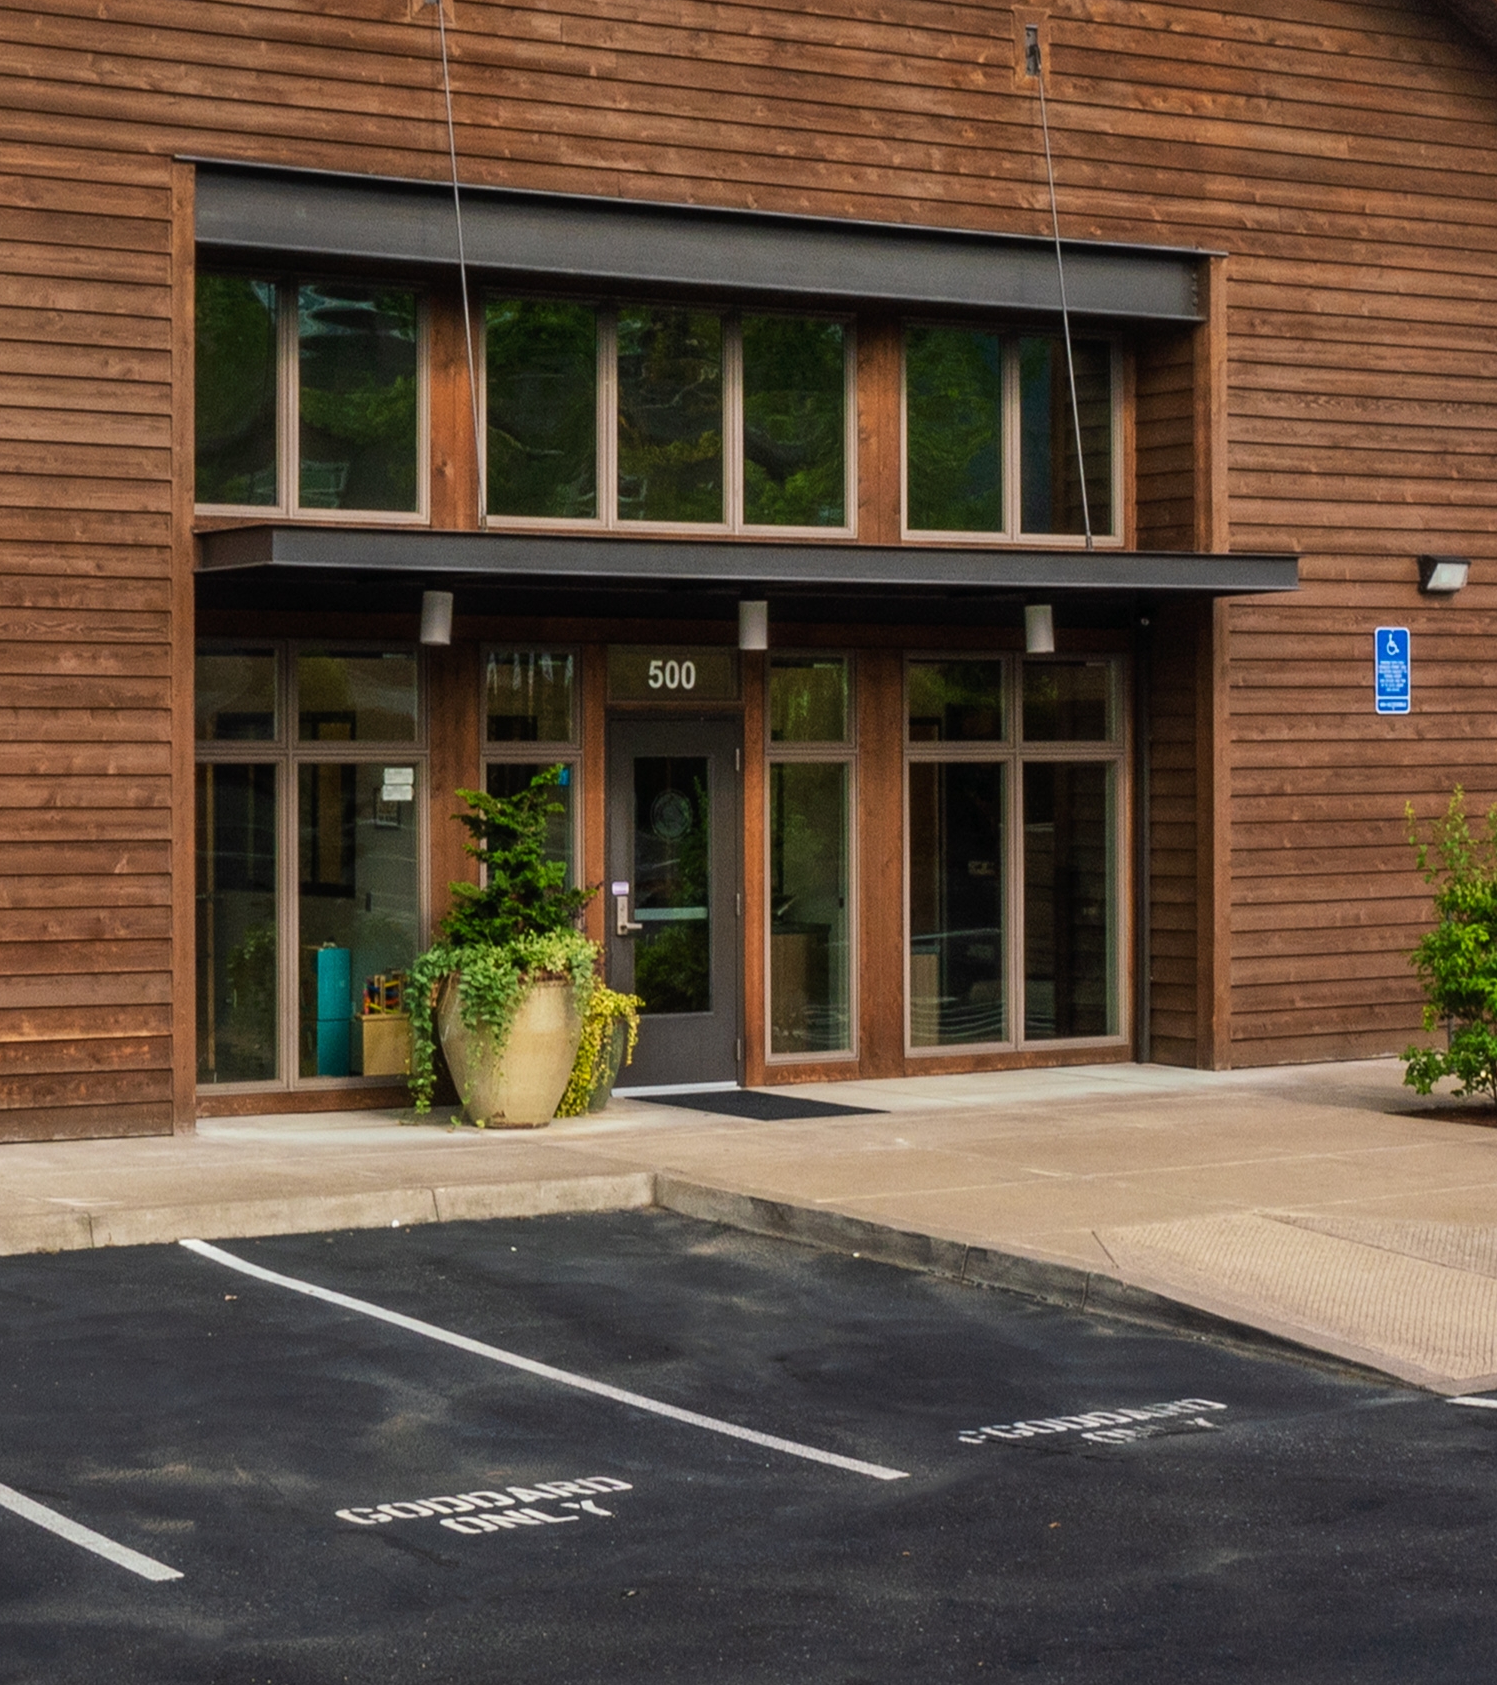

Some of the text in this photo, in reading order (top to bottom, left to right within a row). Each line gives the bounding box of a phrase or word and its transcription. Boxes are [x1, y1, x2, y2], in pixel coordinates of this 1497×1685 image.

[648, 660, 696, 690] 500
[335, 1476, 634, 1525] GODDARD
[439, 1499, 613, 1534] ONLY
